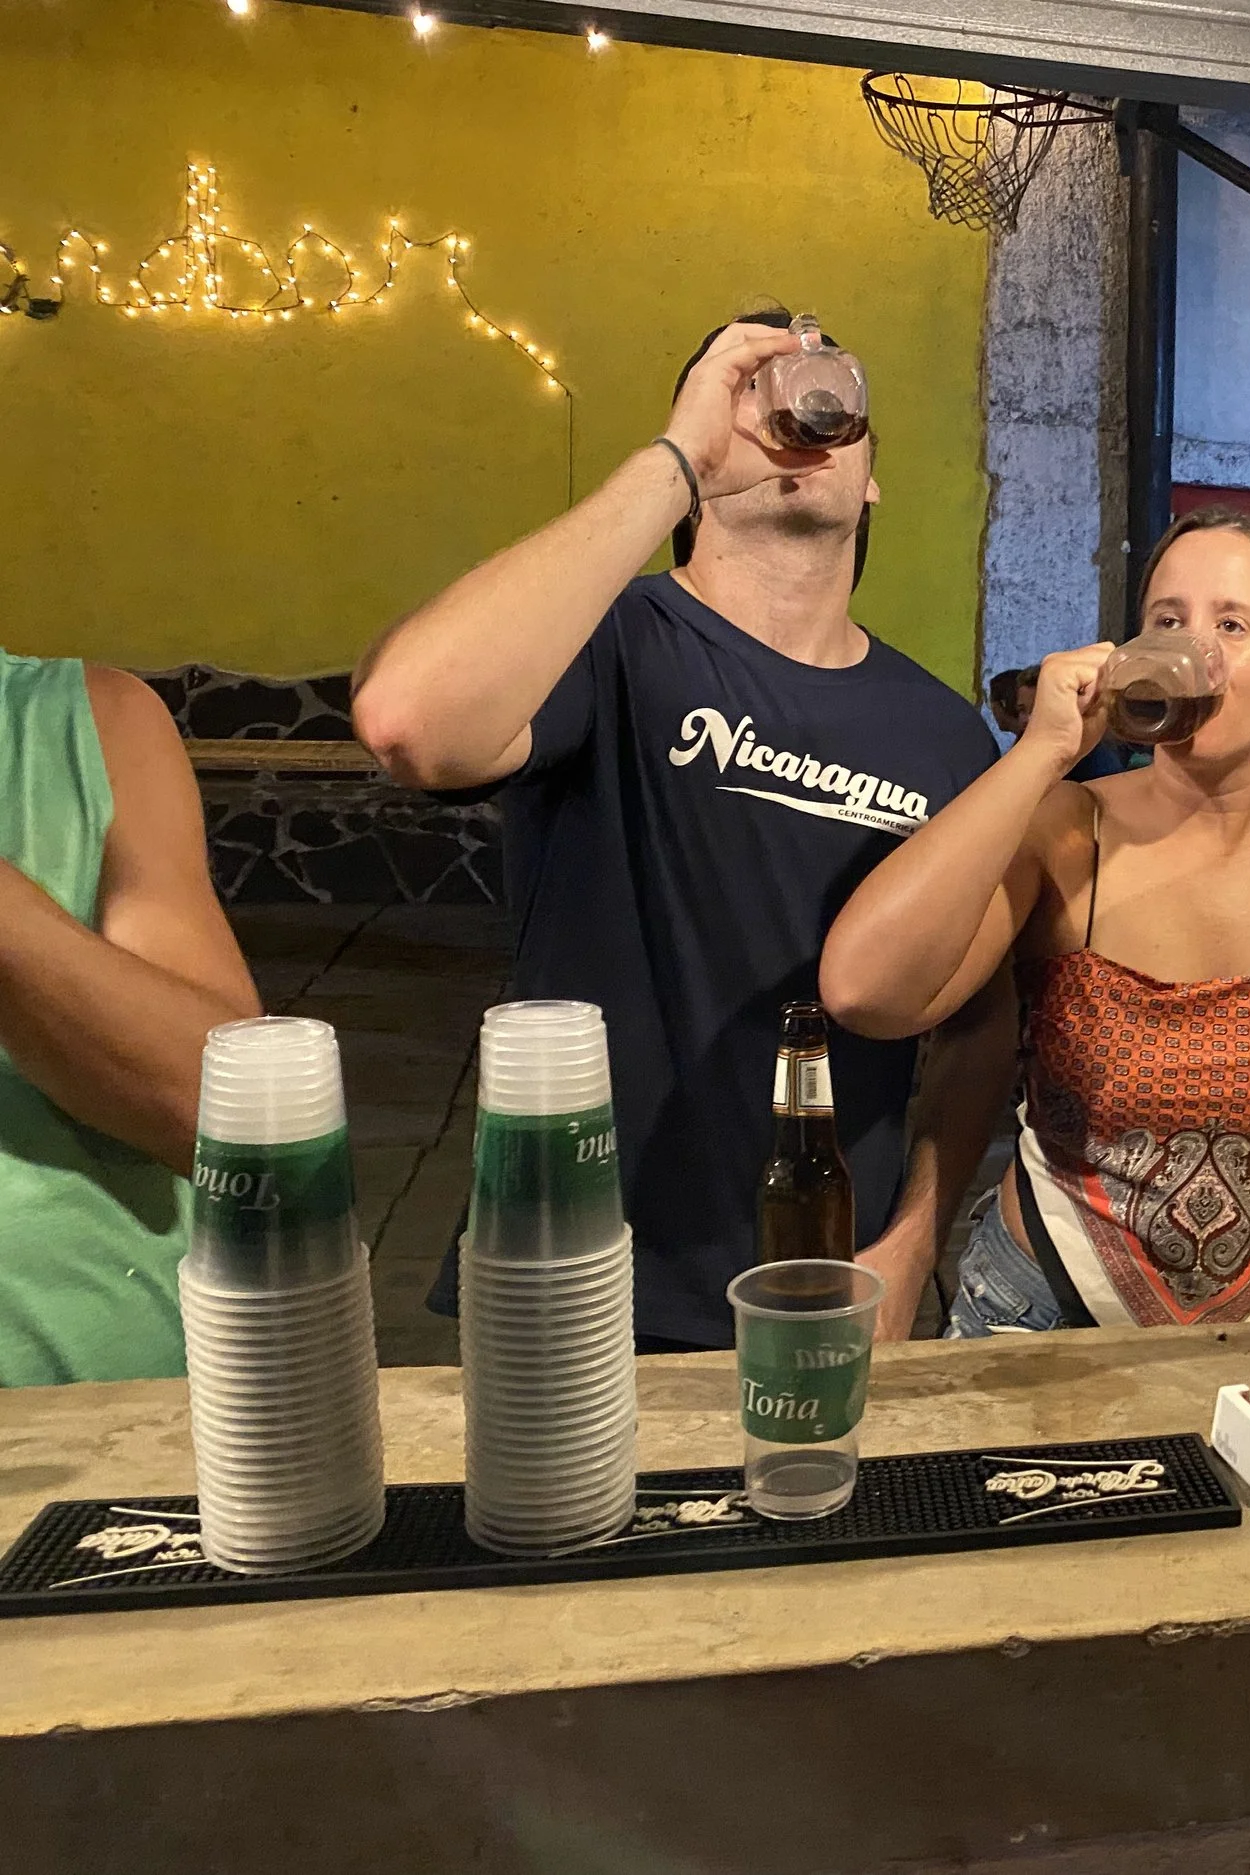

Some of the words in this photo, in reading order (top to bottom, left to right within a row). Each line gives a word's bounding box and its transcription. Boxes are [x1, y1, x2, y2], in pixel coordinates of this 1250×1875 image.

[667, 707, 930, 823] Nicaragua
[195, 1162, 281, 1211] Toña
[743, 1377, 820, 1421] Toña
